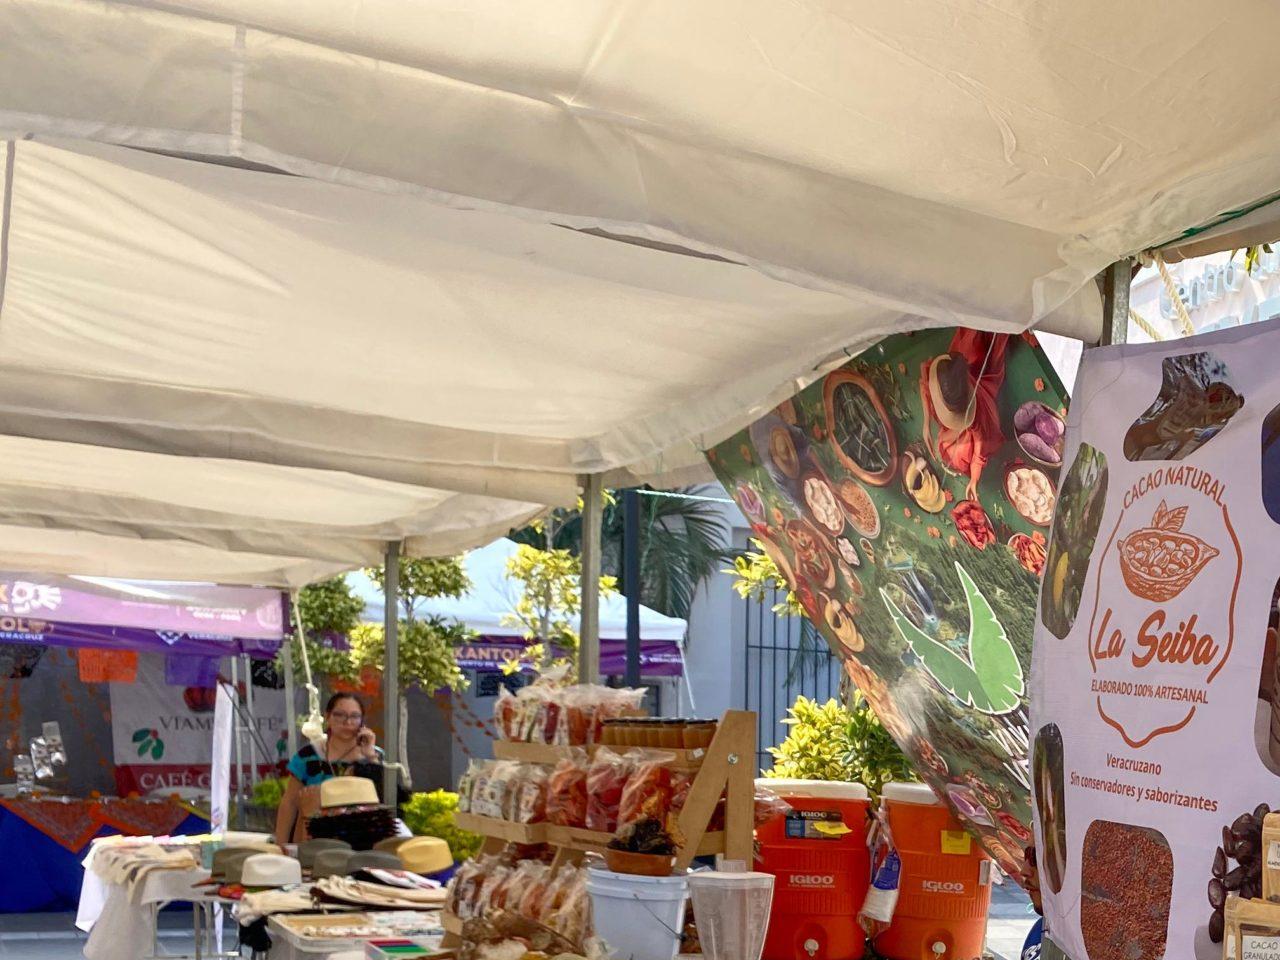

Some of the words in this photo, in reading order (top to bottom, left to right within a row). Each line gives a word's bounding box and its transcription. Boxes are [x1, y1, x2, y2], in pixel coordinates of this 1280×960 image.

[1123, 468, 1163, 509] CACAO
[1165, 466, 1226, 506] NATURAL
[1095, 608, 1126, 660] La
[1131, 609, 1219, 668] Seiba
[1091, 679, 1132, 696] ELABORADO
[1133, 684, 1154, 698] 100%
[1154, 685, 1208, 704] ARTESANAL
[1106, 753, 1162, 776] Veracruzano
[1070, 771, 1080, 786] Sin
[1080, 776, 1135, 797] conservadores
[1136, 786, 1144, 802] y
[1145, 787, 1219, 812] saborizantes
[790, 874, 835, 884] IGLOO
[922, 880, 964, 892] IGLOO
[1250, 940, 1279, 950] CACAO
